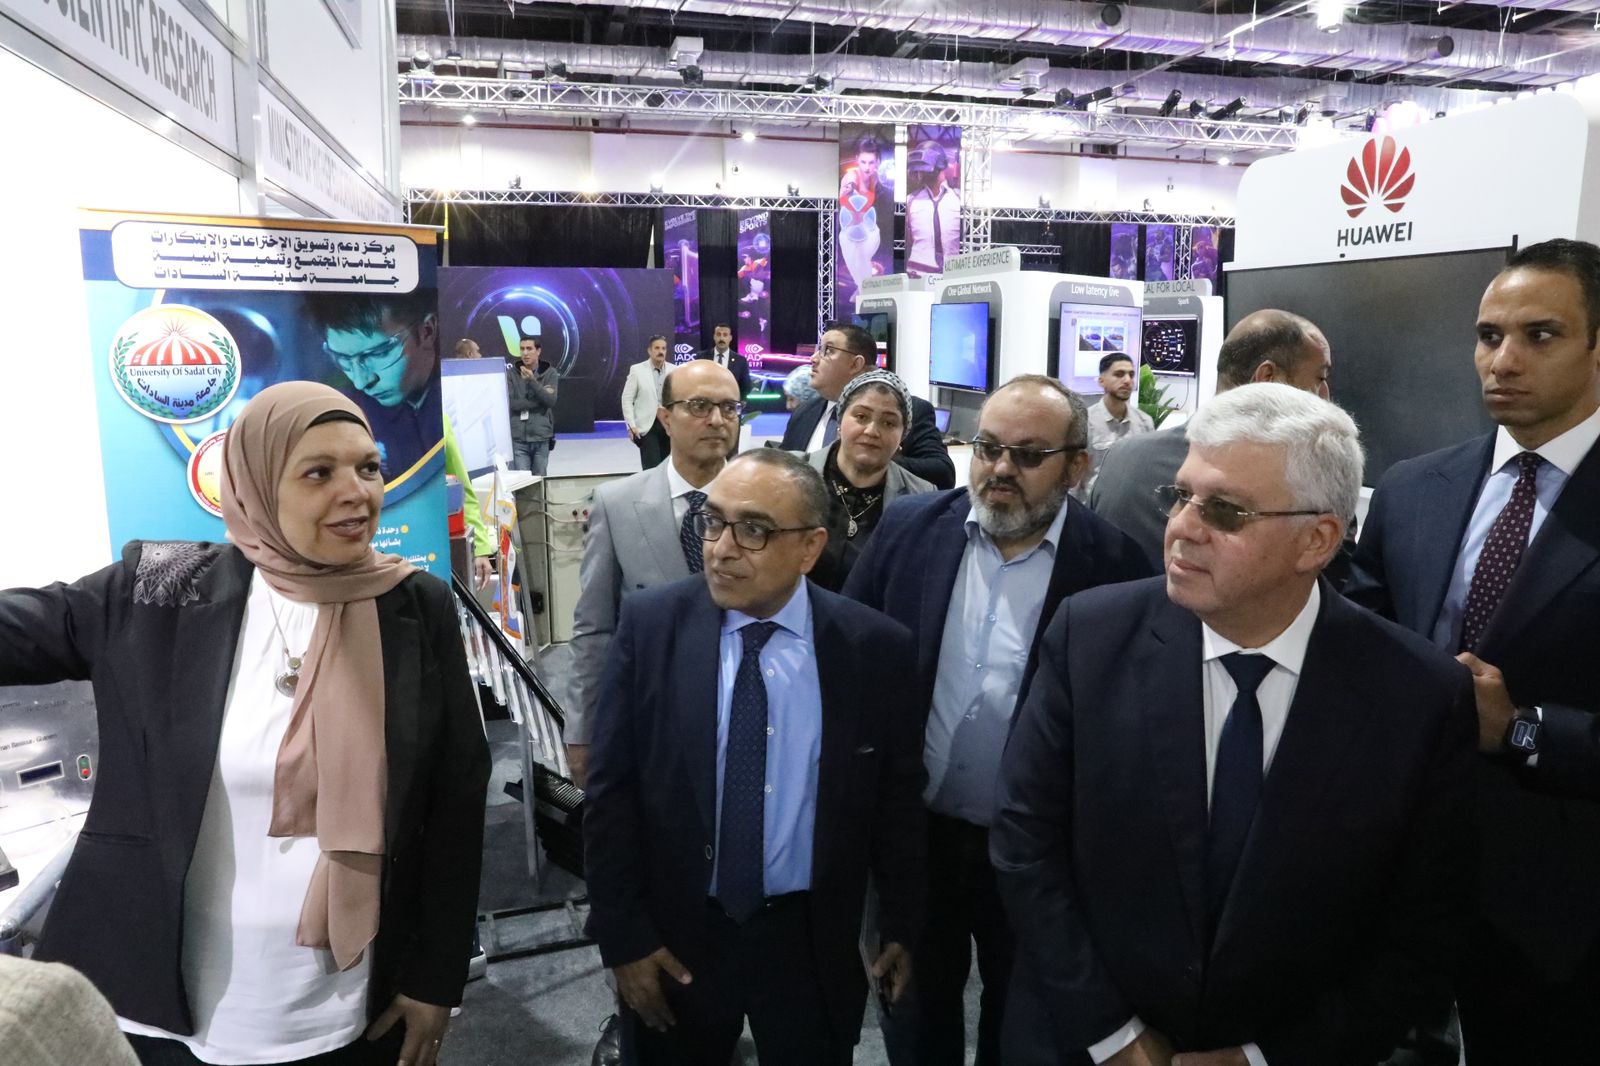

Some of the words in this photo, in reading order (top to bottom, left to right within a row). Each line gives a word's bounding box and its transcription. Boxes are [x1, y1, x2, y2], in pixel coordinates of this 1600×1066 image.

[150, 0, 218, 122] RESEARCH
[739, 211, 769, 226] BEYOND
[739, 219, 768, 233] SPORTS
[1337, 221, 1413, 247] HUAWEI
[294, 237, 335, 253] وتسويق
[338, 240, 359, 253] دعم
[362, 240, 395, 255] مركز
[222, 252, 292, 268] وتنمية
[295, 255, 340, 270] المجتمع
[342, 257, 396, 268] لخدمة
[945, 256, 972, 271] ULTIMATE
[973, 250, 1011, 268] EXPERIENCE
[154, 267, 231, 281] السادات
[233, 270, 308, 285] مدينة
[309, 272, 400, 288] جامعة
[948, 287, 957, 296] One
[957, 285, 972, 296] Global
[972, 283, 992, 294] Network
[1071, 284, 1085, 295] Low
[1086, 285, 1107, 298] latency
[1109, 286, 1120, 298] live
[1156, 282, 1171, 293] FOR
[1172, 281, 1195, 293] LOCAL
[130, 368, 170, 378] University
[172, 367, 182, 376] Of
[184, 366, 206, 376] Sadat
[207, 366, 222, 378] City
[137, 378, 170, 406] السادات
[195, 377, 217, 402] جامعة
[172, 397, 194, 410] مدينة
